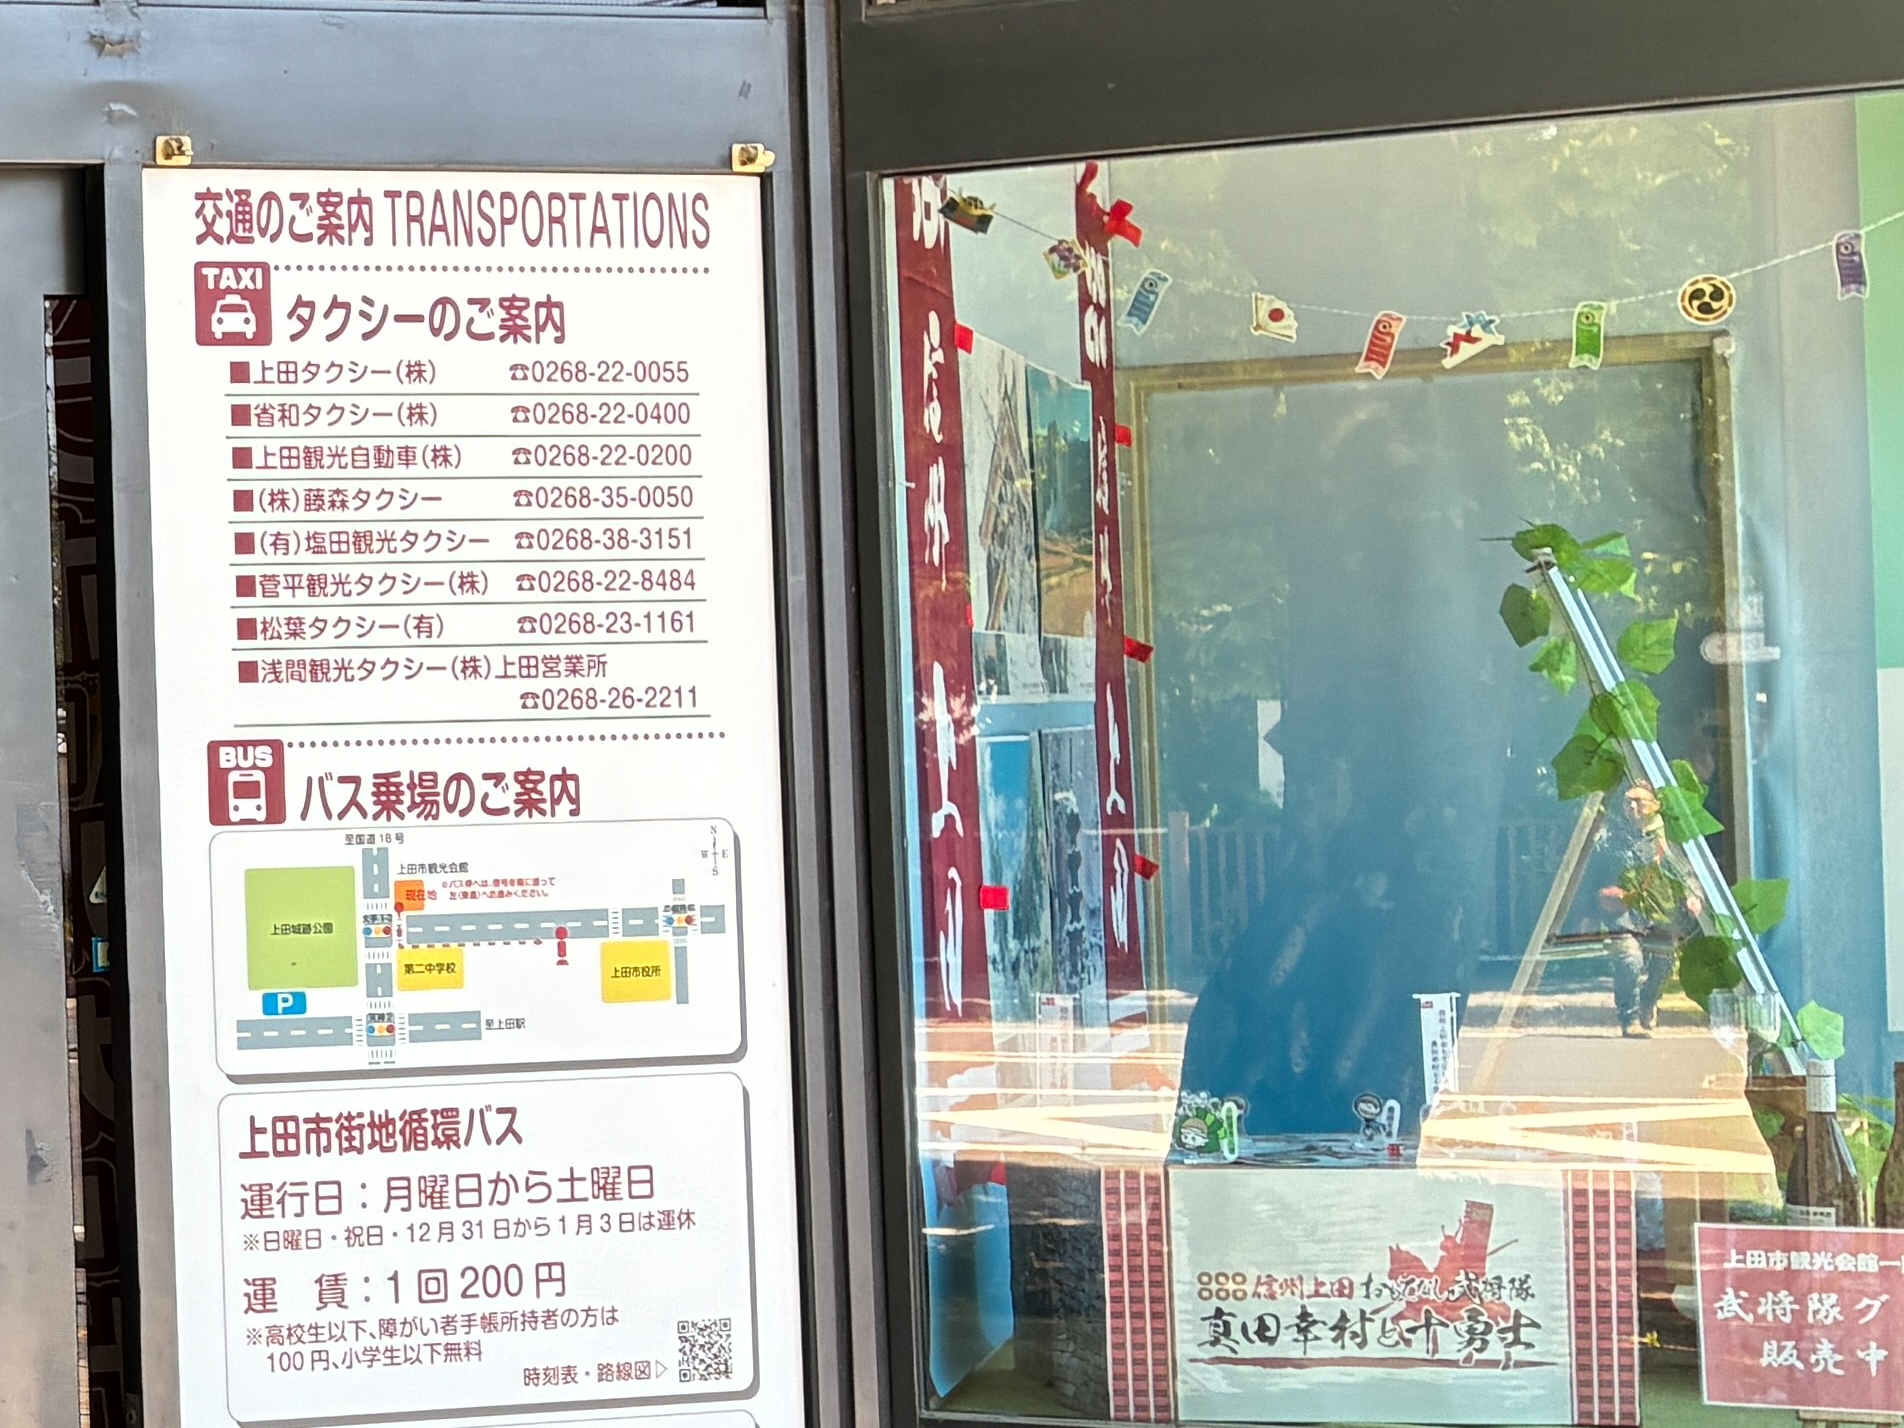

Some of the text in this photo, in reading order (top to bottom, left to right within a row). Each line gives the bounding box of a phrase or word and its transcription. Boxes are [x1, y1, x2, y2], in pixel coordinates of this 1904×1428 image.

[194, 188, 711, 249] 交通のご案内 TRANSPORTATIONS
[201, 267, 262, 289] TAXI
[286, 294, 566, 344] タクシーのご案内
[253, 360, 689, 386] 上田タクシー(株) 0268-22-0055
[254, 402, 690, 428] 省和タクシー(株) 0268-22-0400
[255, 445, 691, 470] 上田観光自動車(株) 0268-22-0200
[258, 486, 693, 513] (株)藤森タクシー 0268-35-0050
[260, 528, 692, 556] (有)塩田観光タクシー 0268-38-3151
[259, 569, 695, 597] 菅平観光タクシー(株) 0268-22-8484
[260, 611, 694, 640] 松葉タクシー(有) 0268-23-1161
[261, 653, 607, 683] 浅間観光タクシー(株)上田営業所
[542, 686, 697, 710] 0268-26-2211
[219, 746, 273, 768] BUS
[300, 768, 581, 822] バス乗場のご案内
[278, 994, 293, 1013] P
[239, 1105, 523, 1160] 上田市街地循環バス
[240, 1165, 654, 1219] 運行日：月曜日から土曜日
[1723, 1249, 1904, 1272] 上田市観光会館一
[1252, 1274, 1353, 1301] 信州上田
[1714, 1287, 1890, 1324] 武将隊グ
[1197, 1304, 1542, 1356] 真田幸村と十勇士
[1760, 1338, 1888, 1377] 販売中
[523, 1361, 651, 1386] 時刻表・路線図
